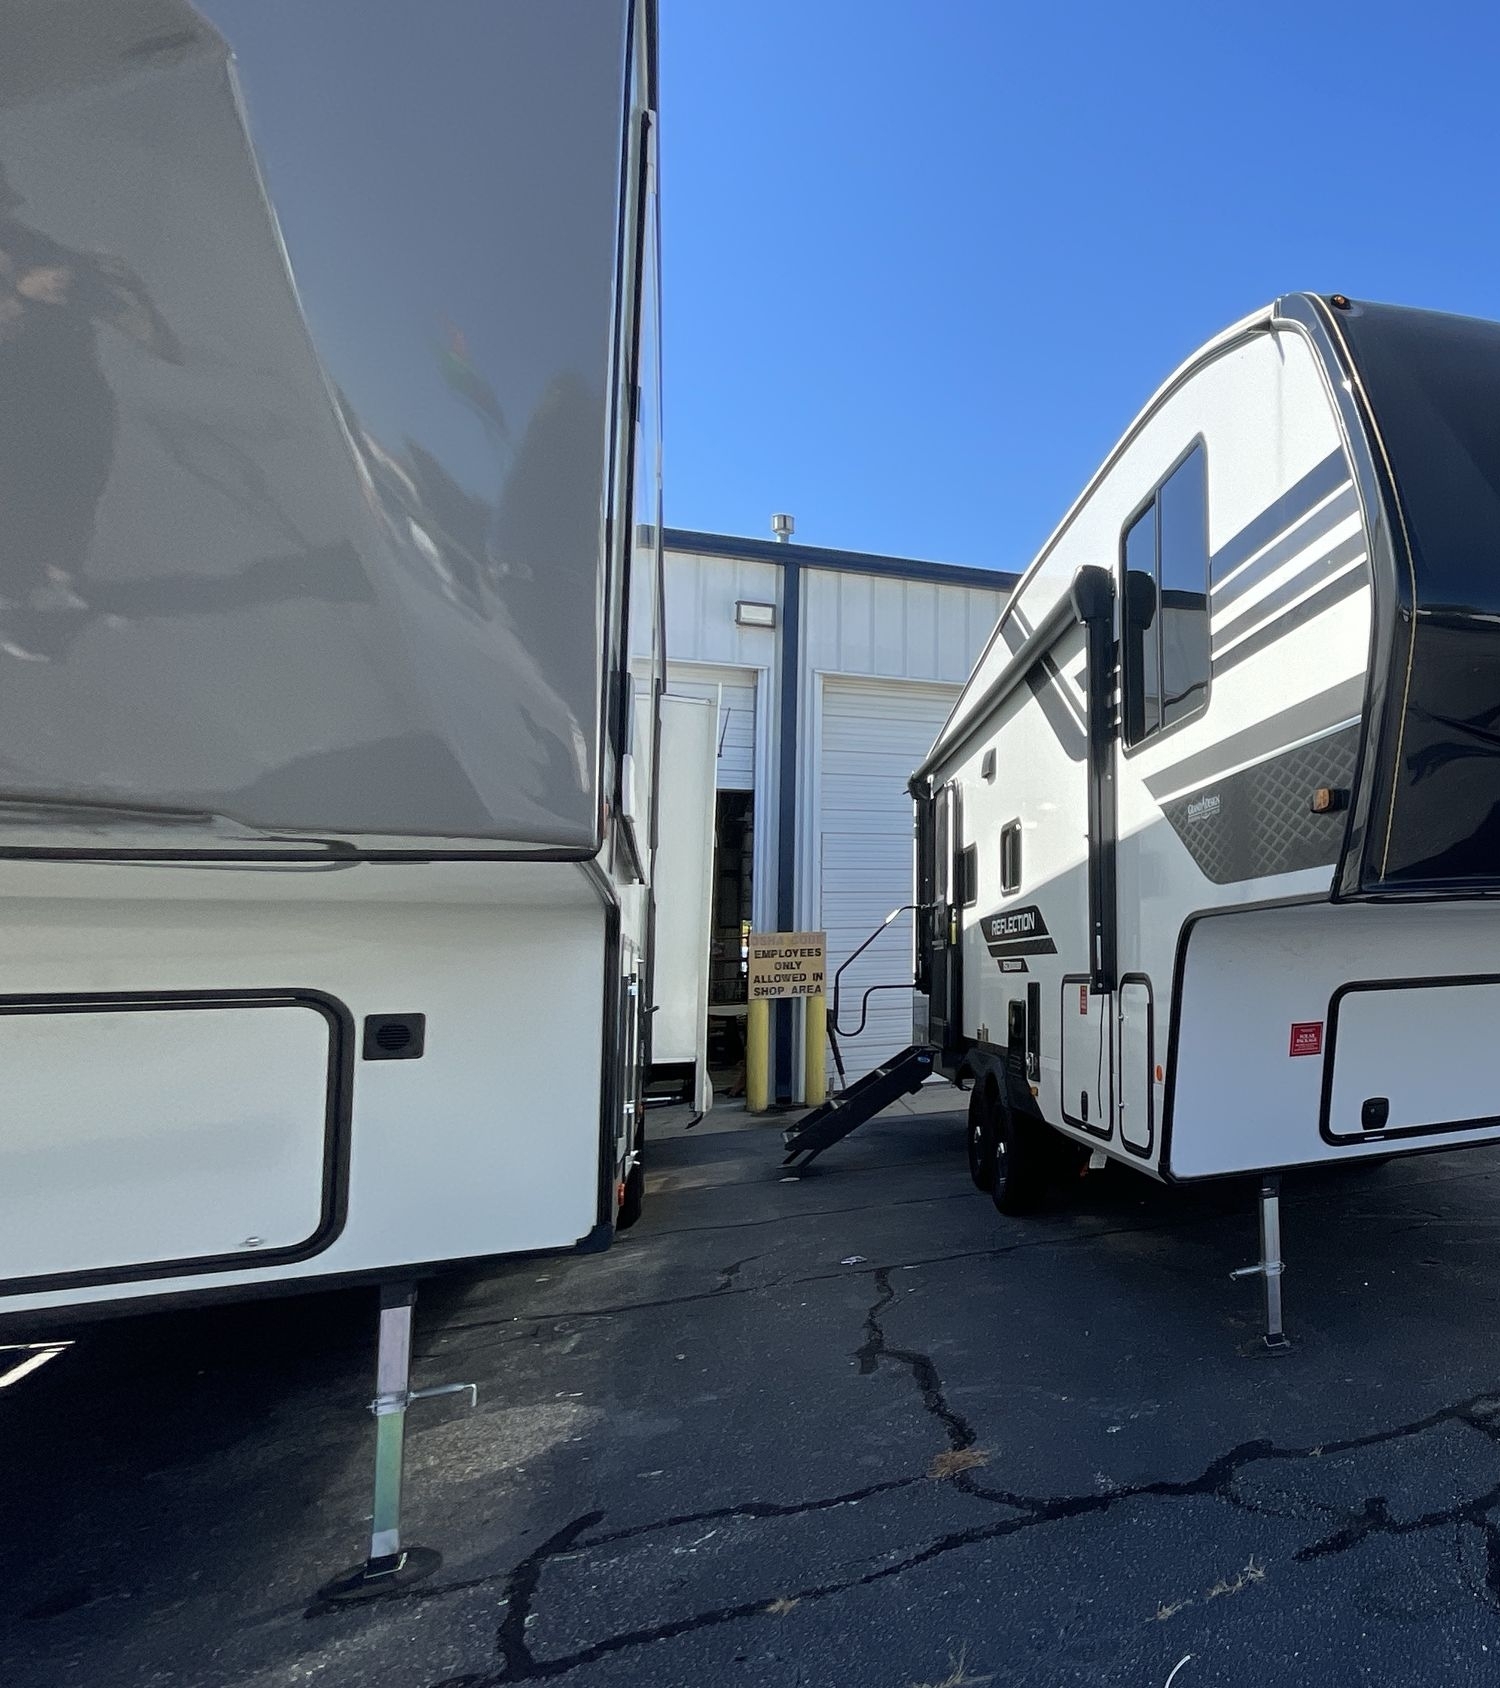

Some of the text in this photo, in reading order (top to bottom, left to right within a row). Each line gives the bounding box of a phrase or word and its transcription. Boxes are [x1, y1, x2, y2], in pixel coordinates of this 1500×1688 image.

[991, 911, 1035, 936] REFLECTION
[754, 948, 822, 959] EMPLOYEES
[774, 961, 802, 970] ONLY
[753, 972, 823, 984] ALLOWED IN
[753, 984, 822, 997] SHOP AREA
